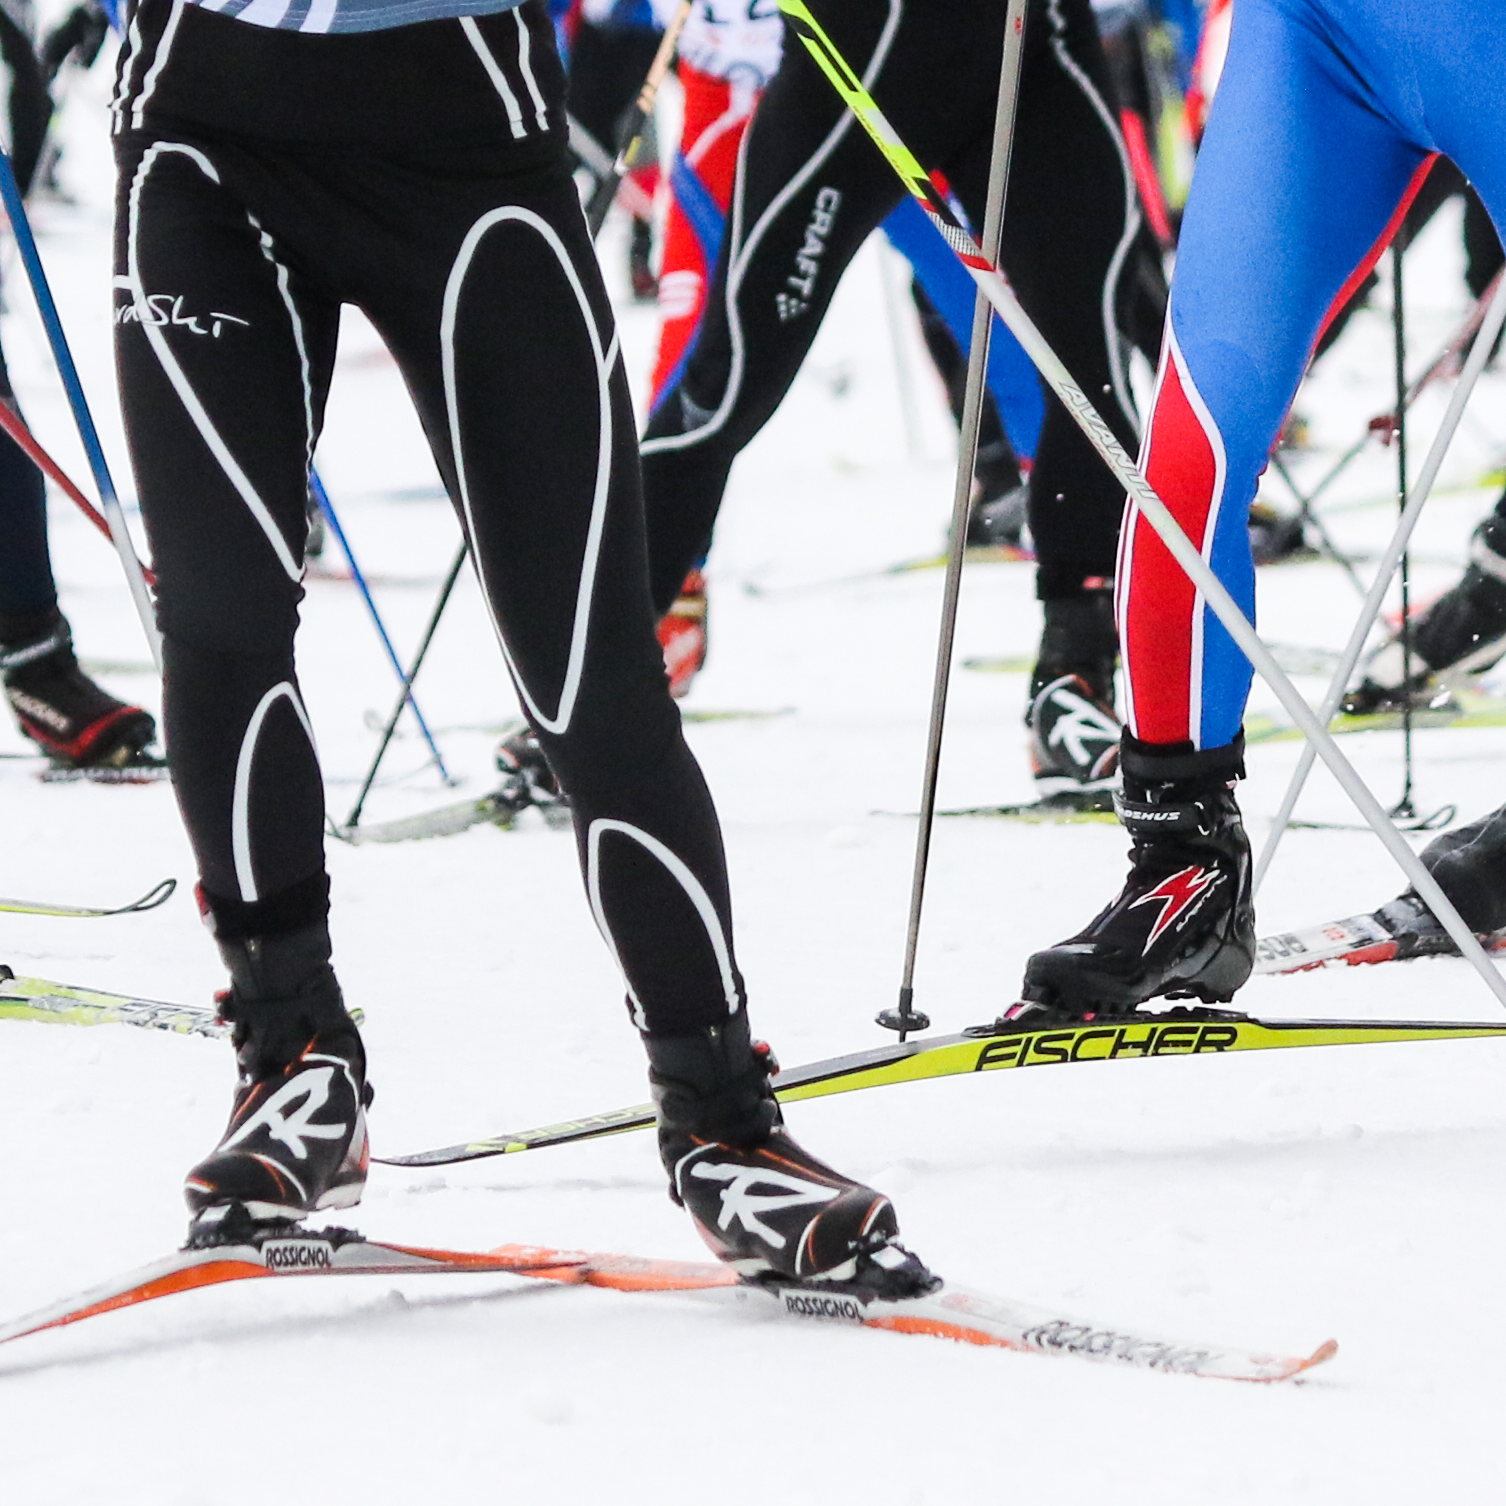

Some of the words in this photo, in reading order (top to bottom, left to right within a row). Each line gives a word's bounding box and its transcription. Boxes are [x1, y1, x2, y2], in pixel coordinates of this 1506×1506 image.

[787, 186, 844, 297] CRAFT
[974, 1025, 1239, 1072] FISCHER
[266, 1246, 333, 1268] ROSSIGNOL
[785, 1294, 866, 1322] ROSSIGNOL
